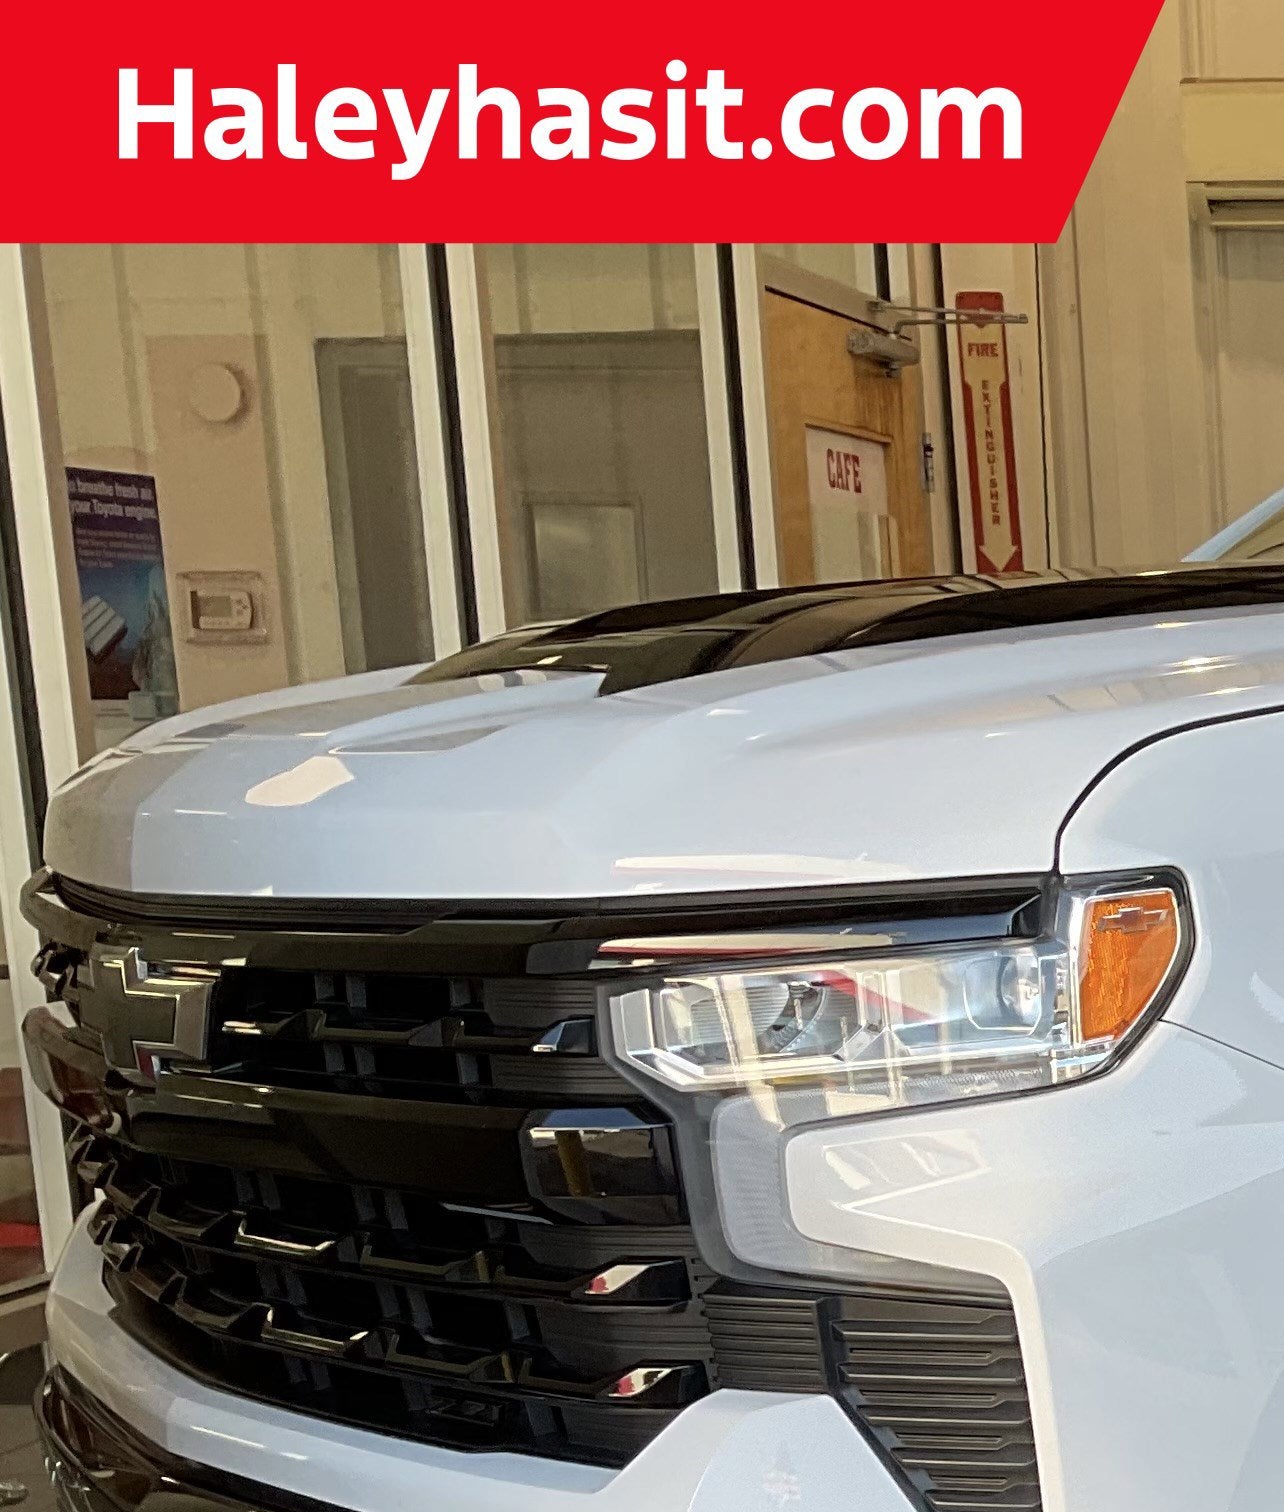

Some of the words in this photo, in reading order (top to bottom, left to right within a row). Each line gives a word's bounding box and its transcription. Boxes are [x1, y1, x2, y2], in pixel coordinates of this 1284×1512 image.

[968, 343, 999, 358] FIRE
[827, 448, 862, 493] CAFE
[981, 380, 1001, 526] EXTINGUISHER
